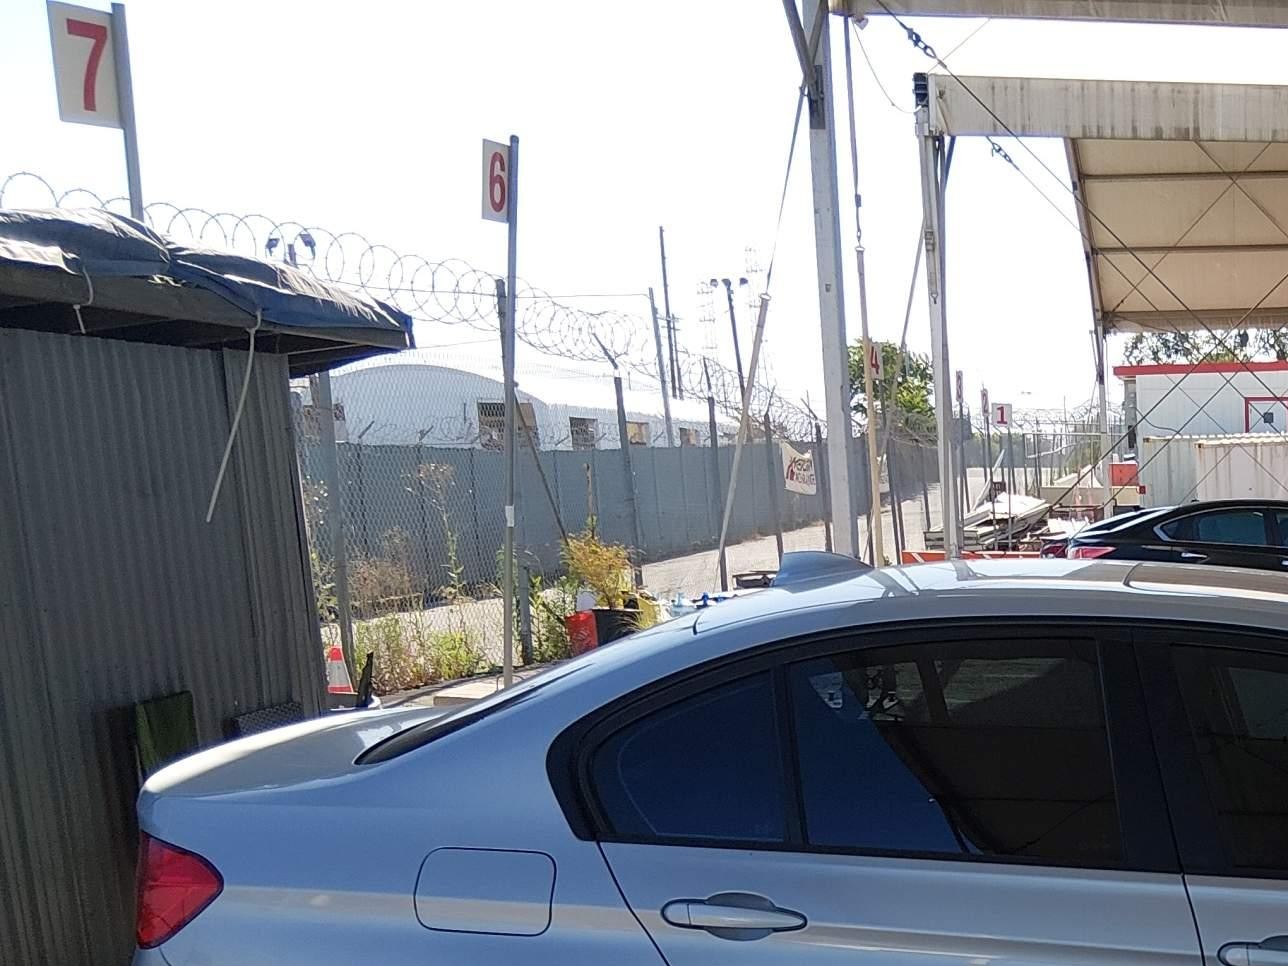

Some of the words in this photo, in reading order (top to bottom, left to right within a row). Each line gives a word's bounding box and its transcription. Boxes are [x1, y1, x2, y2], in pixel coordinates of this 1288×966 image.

[66, 18, 108, 112] 7
[489, 151, 506, 213] 6
[870, 345, 880, 375] 4
[996, 406, 1008, 425] 1
